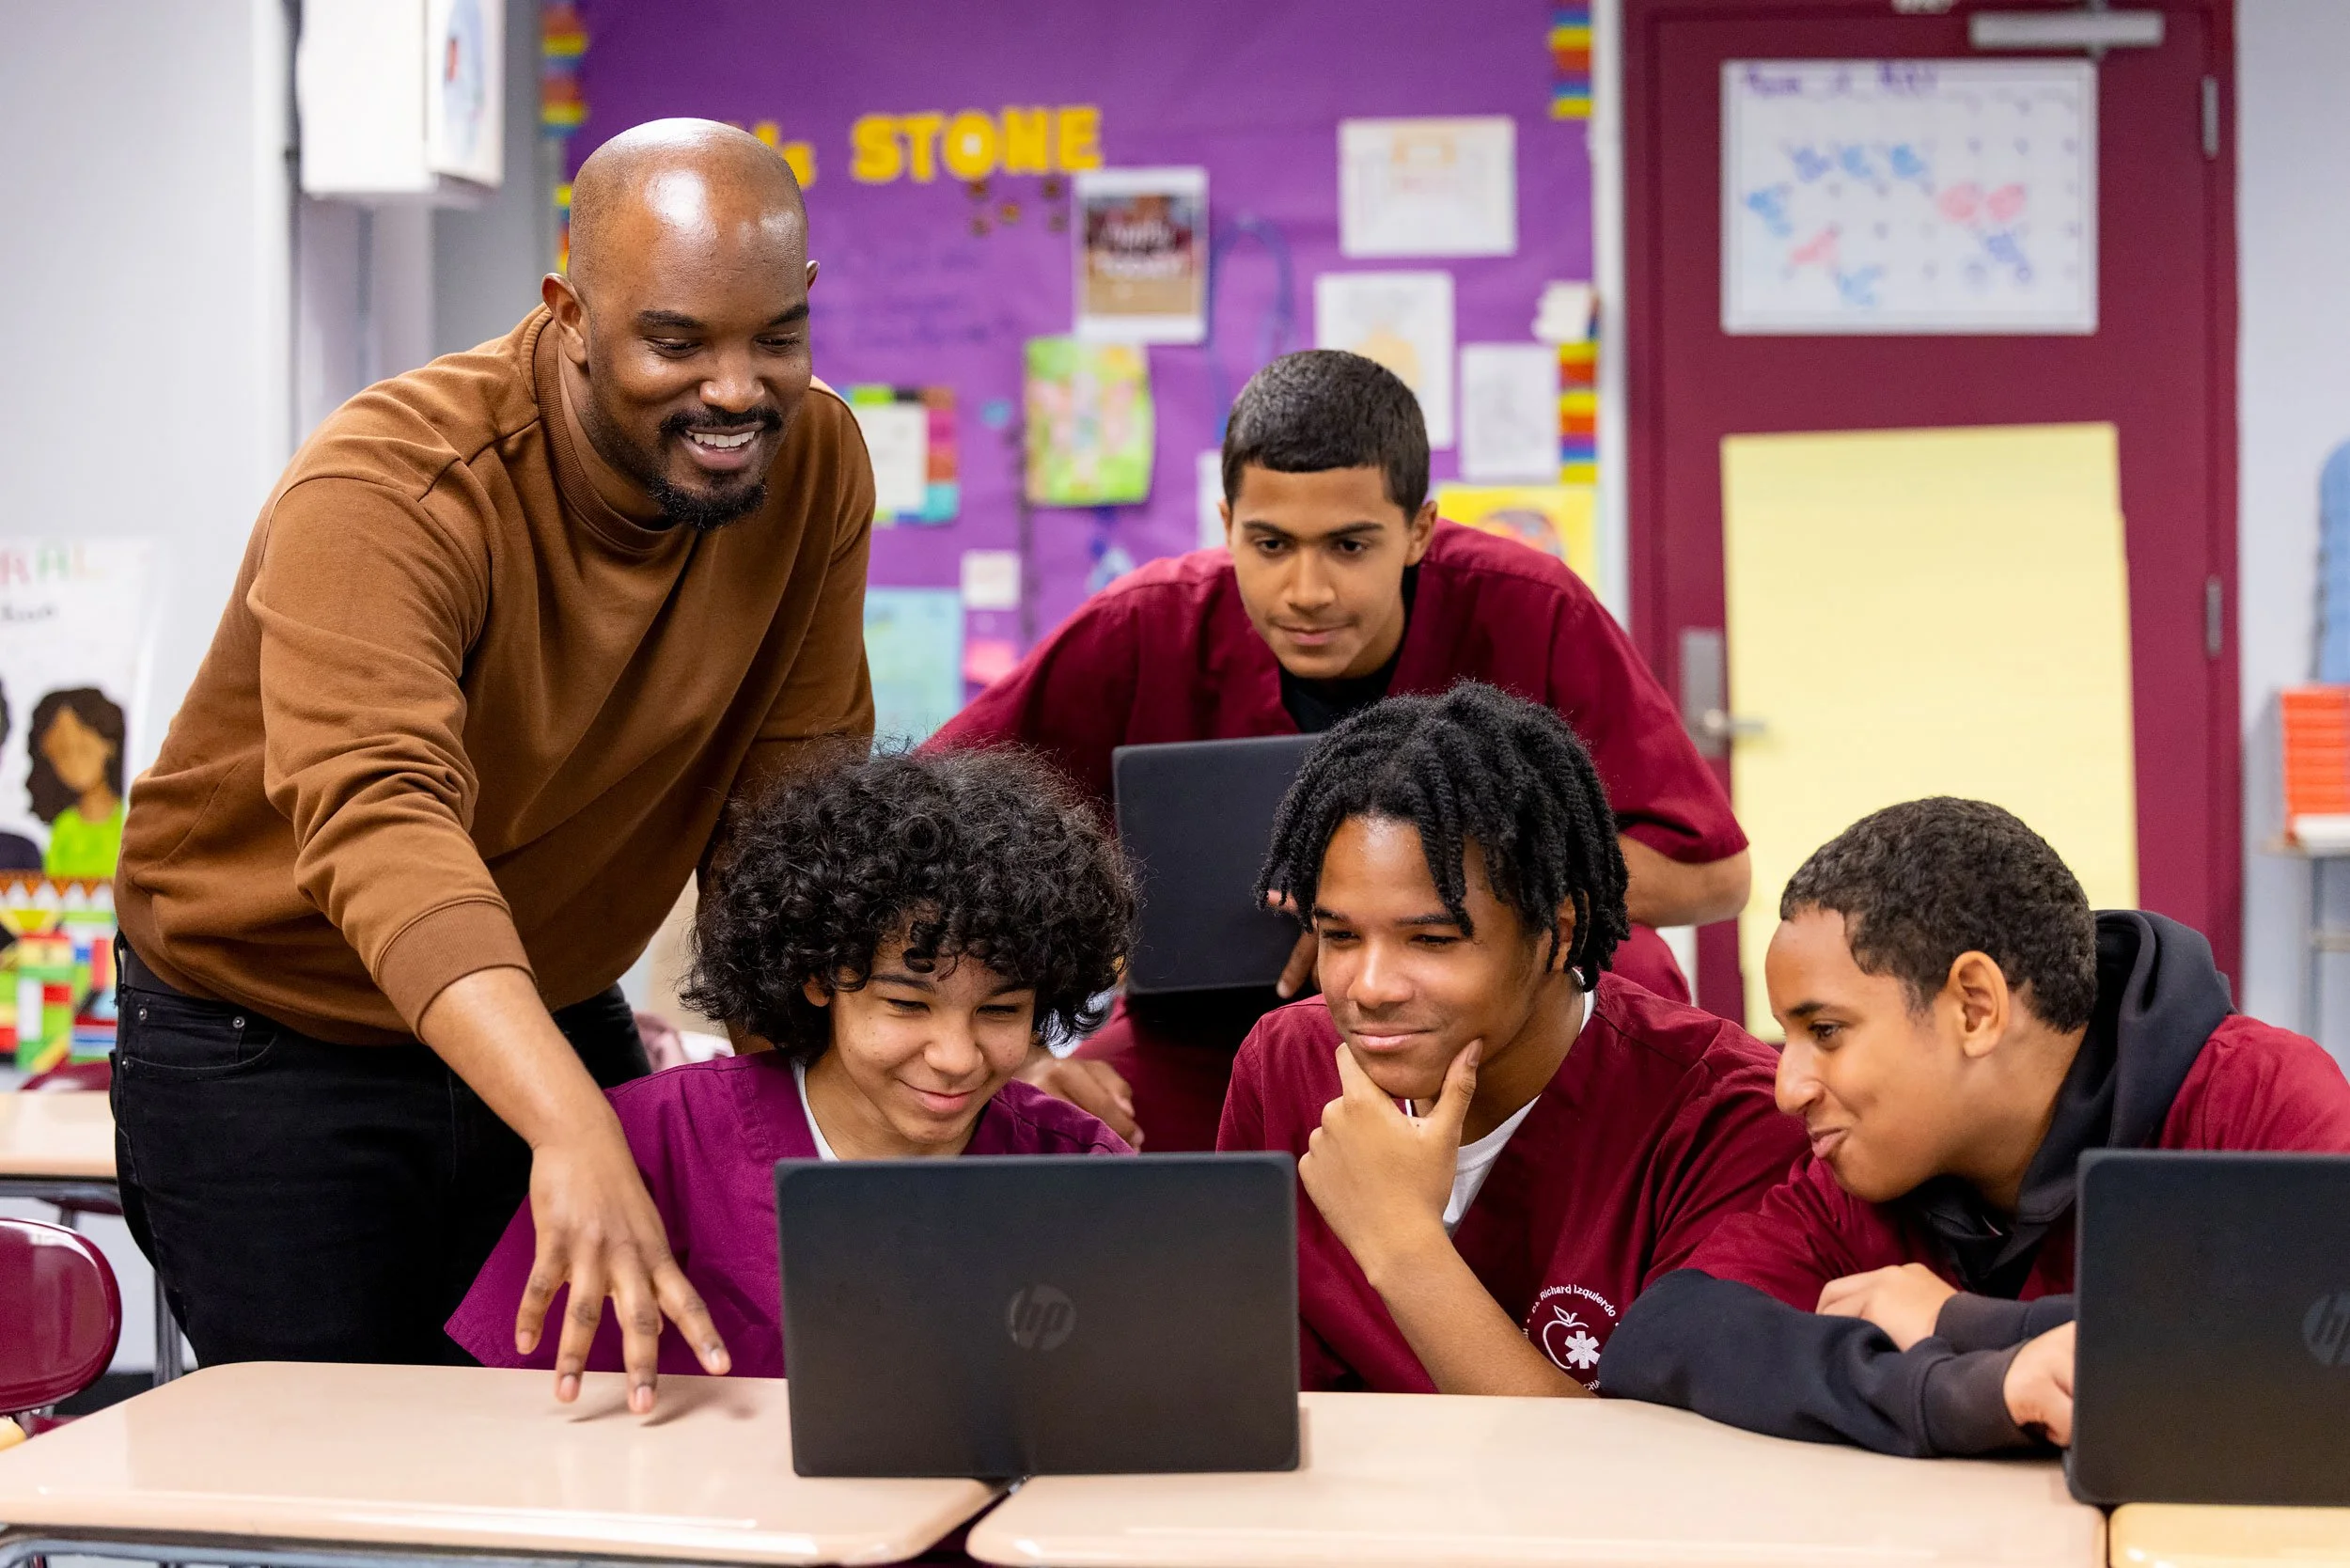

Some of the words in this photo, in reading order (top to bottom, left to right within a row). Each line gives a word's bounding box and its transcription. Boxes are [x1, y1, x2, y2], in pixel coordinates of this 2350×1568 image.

[851, 105, 1102, 182] STONE
[1010, 1284, 1076, 1352] hp
[1539, 1284, 1572, 1301] Richard
[1574, 1284, 1617, 1317] Izquierdo
